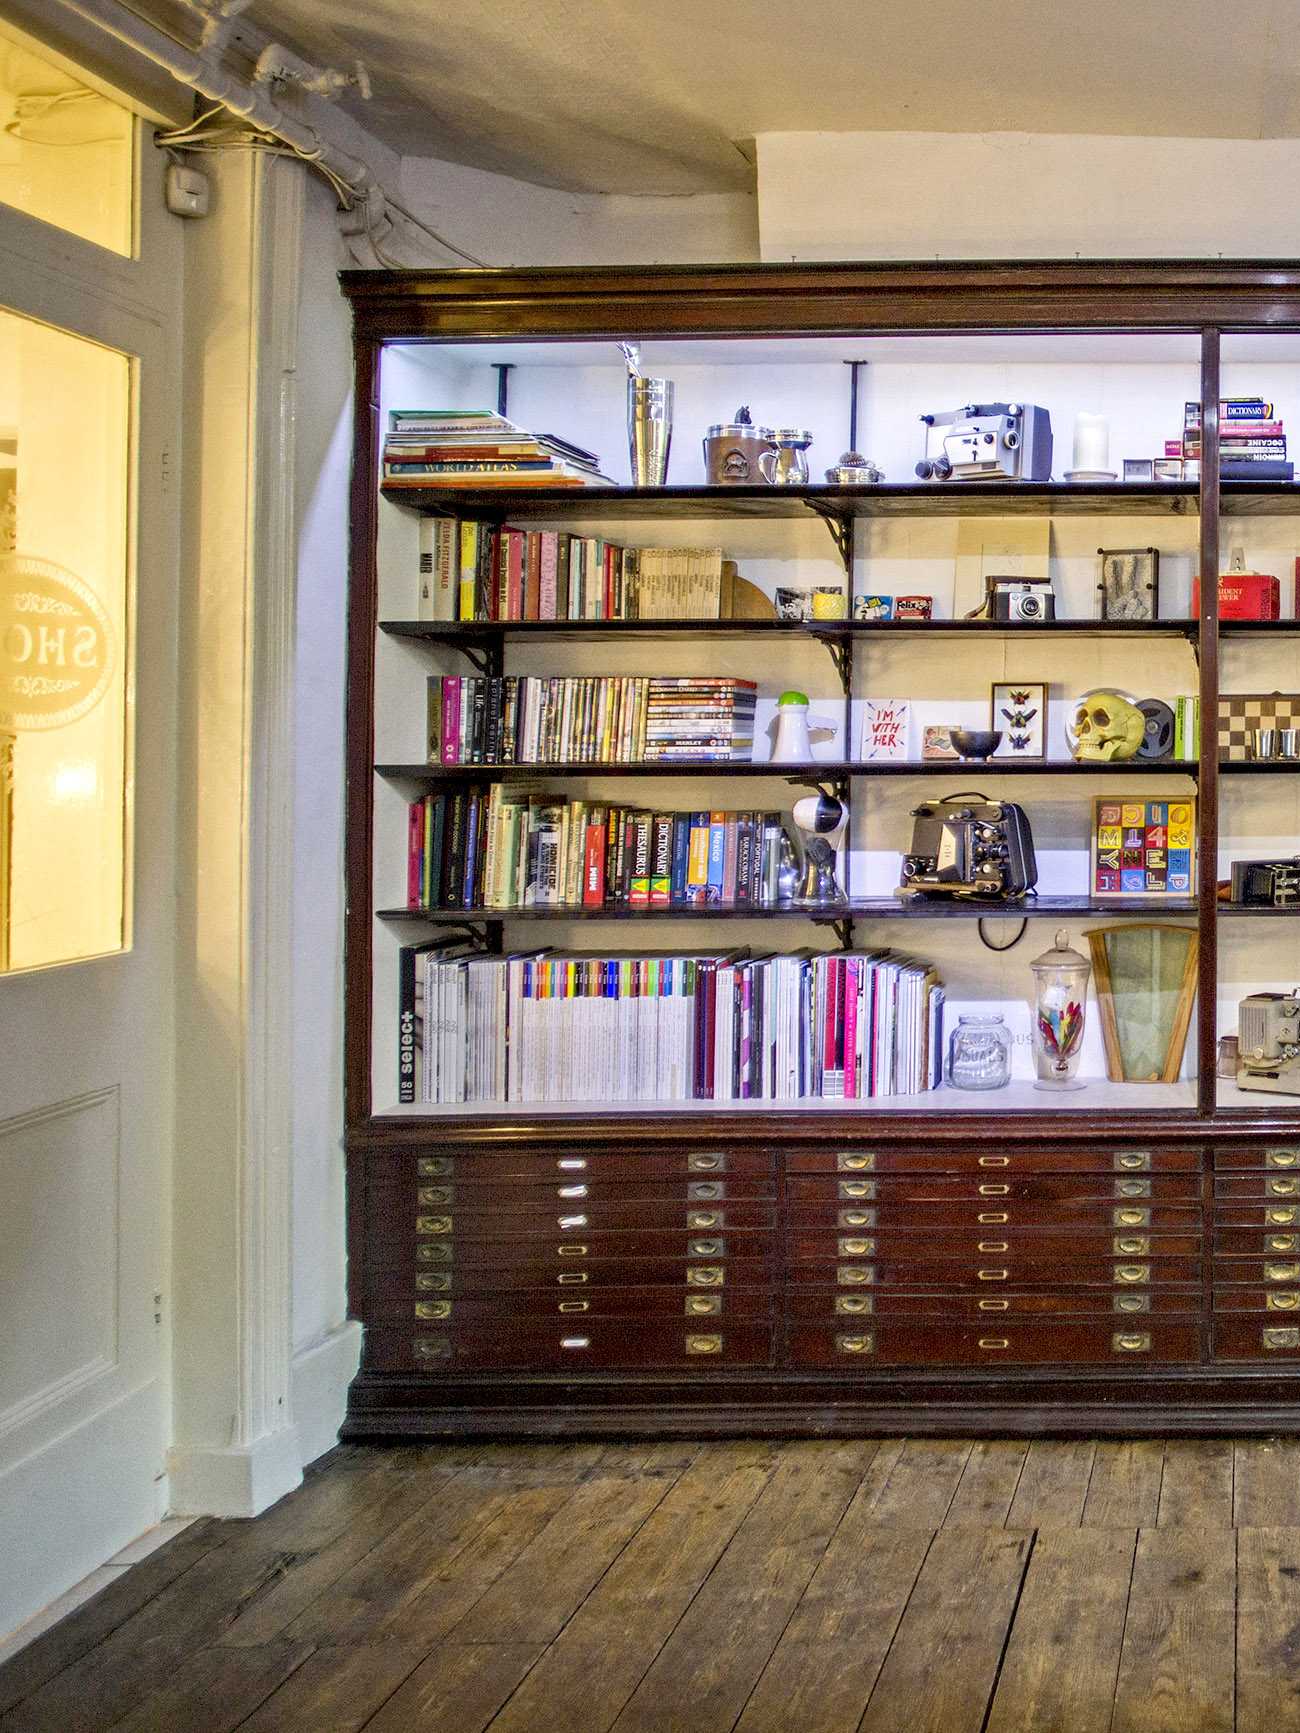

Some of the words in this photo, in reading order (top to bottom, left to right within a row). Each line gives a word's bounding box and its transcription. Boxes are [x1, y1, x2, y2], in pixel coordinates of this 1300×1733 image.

[424, 462, 474, 472] WORLD
[475, 462, 517, 472] ATLAS
[442, 522, 451, 544] ZELDA
[442, 546, 451, 589] FITZGERALD
[897, 600, 916, 609] Felix
[475, 694, 484, 709] Life
[490, 688, 498, 720] planet
[877, 709, 893, 722] I'M
[872, 723, 900, 734] WITH
[874, 734, 897, 748] HER
[636, 824, 648, 875] THESAURUS
[657, 824, 669, 875] DICTIONARY
[712, 831, 722, 862] Mexico
[742, 836, 750, 861] BARACK
[548, 843, 558, 890] HOMICIDE
[754, 843, 762, 875] PORTUGAL
[741, 862, 749, 885] OBAMA
